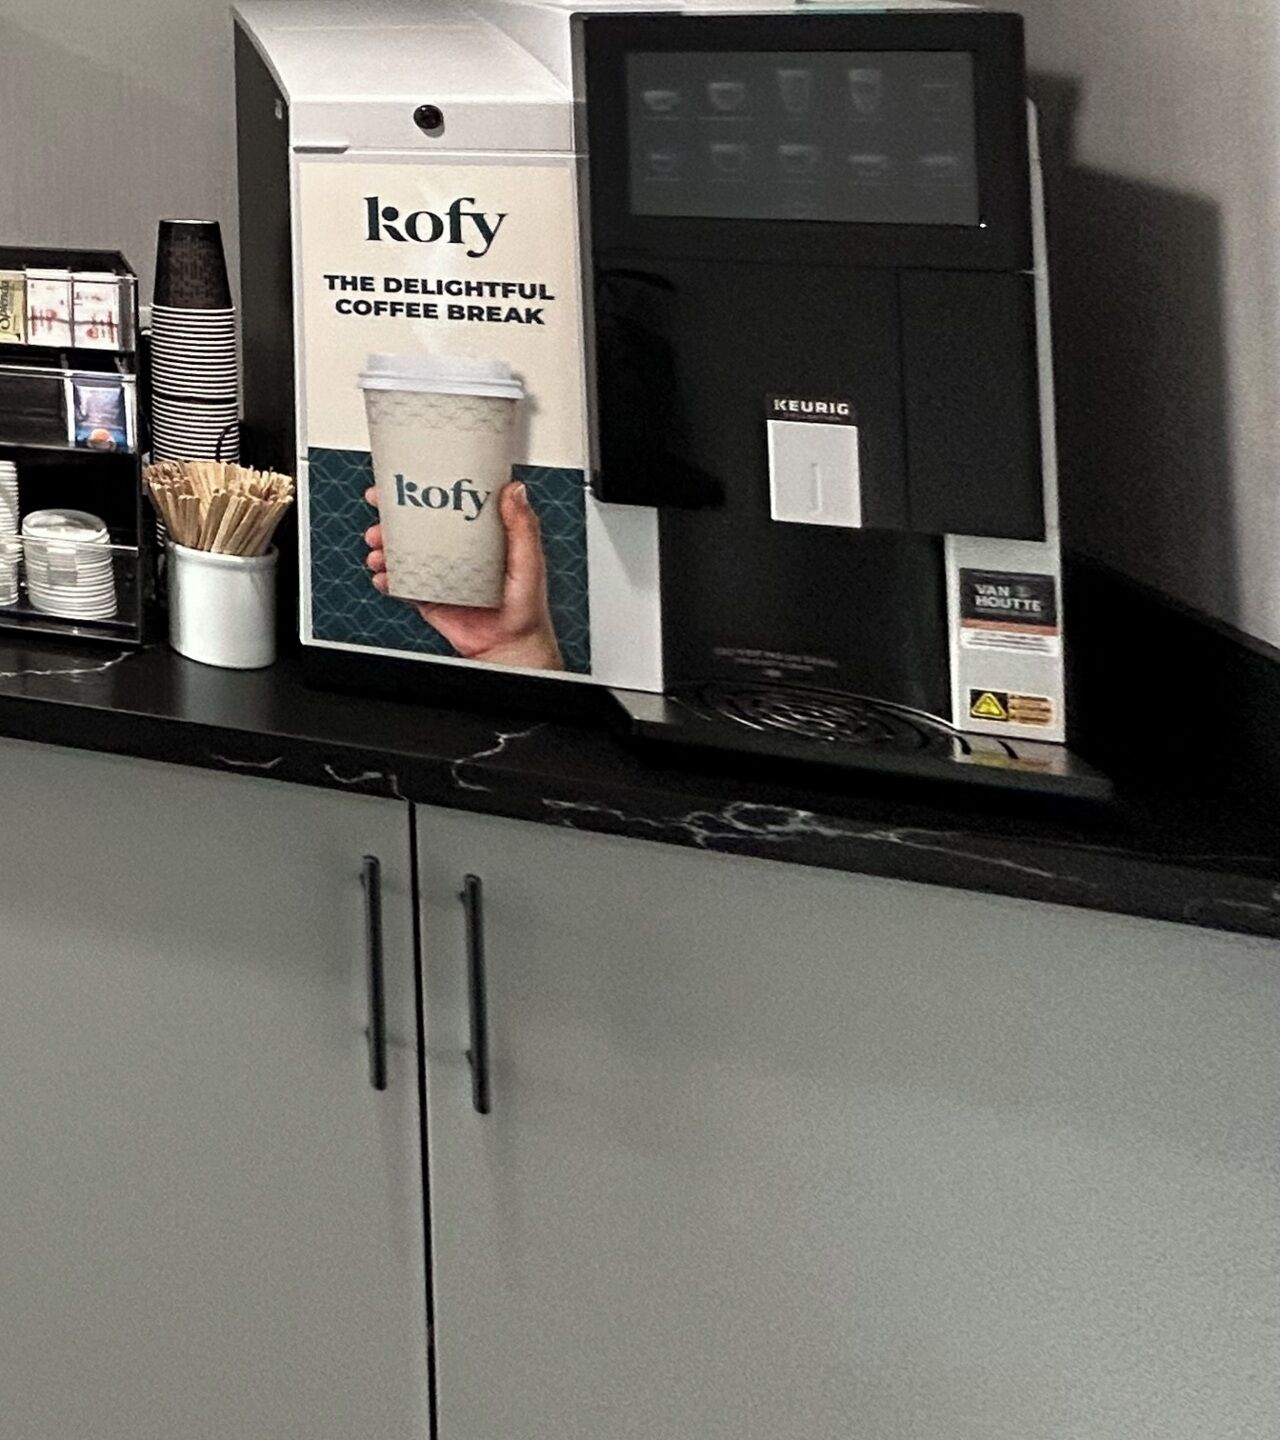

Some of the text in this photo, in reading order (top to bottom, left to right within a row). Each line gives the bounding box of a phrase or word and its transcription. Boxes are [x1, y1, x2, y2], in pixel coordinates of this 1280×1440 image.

[363, 196, 508, 258] kofy
[323, 274, 555, 301] THE DELIGHTFUL
[335, 298, 545, 325] COFFEE BREAK
[773, 398, 850, 416] KEURIG
[393, 473, 492, 521] kofy
[974, 583, 1010, 598] VAN
[975, 595, 1043, 613] HOUTTE
